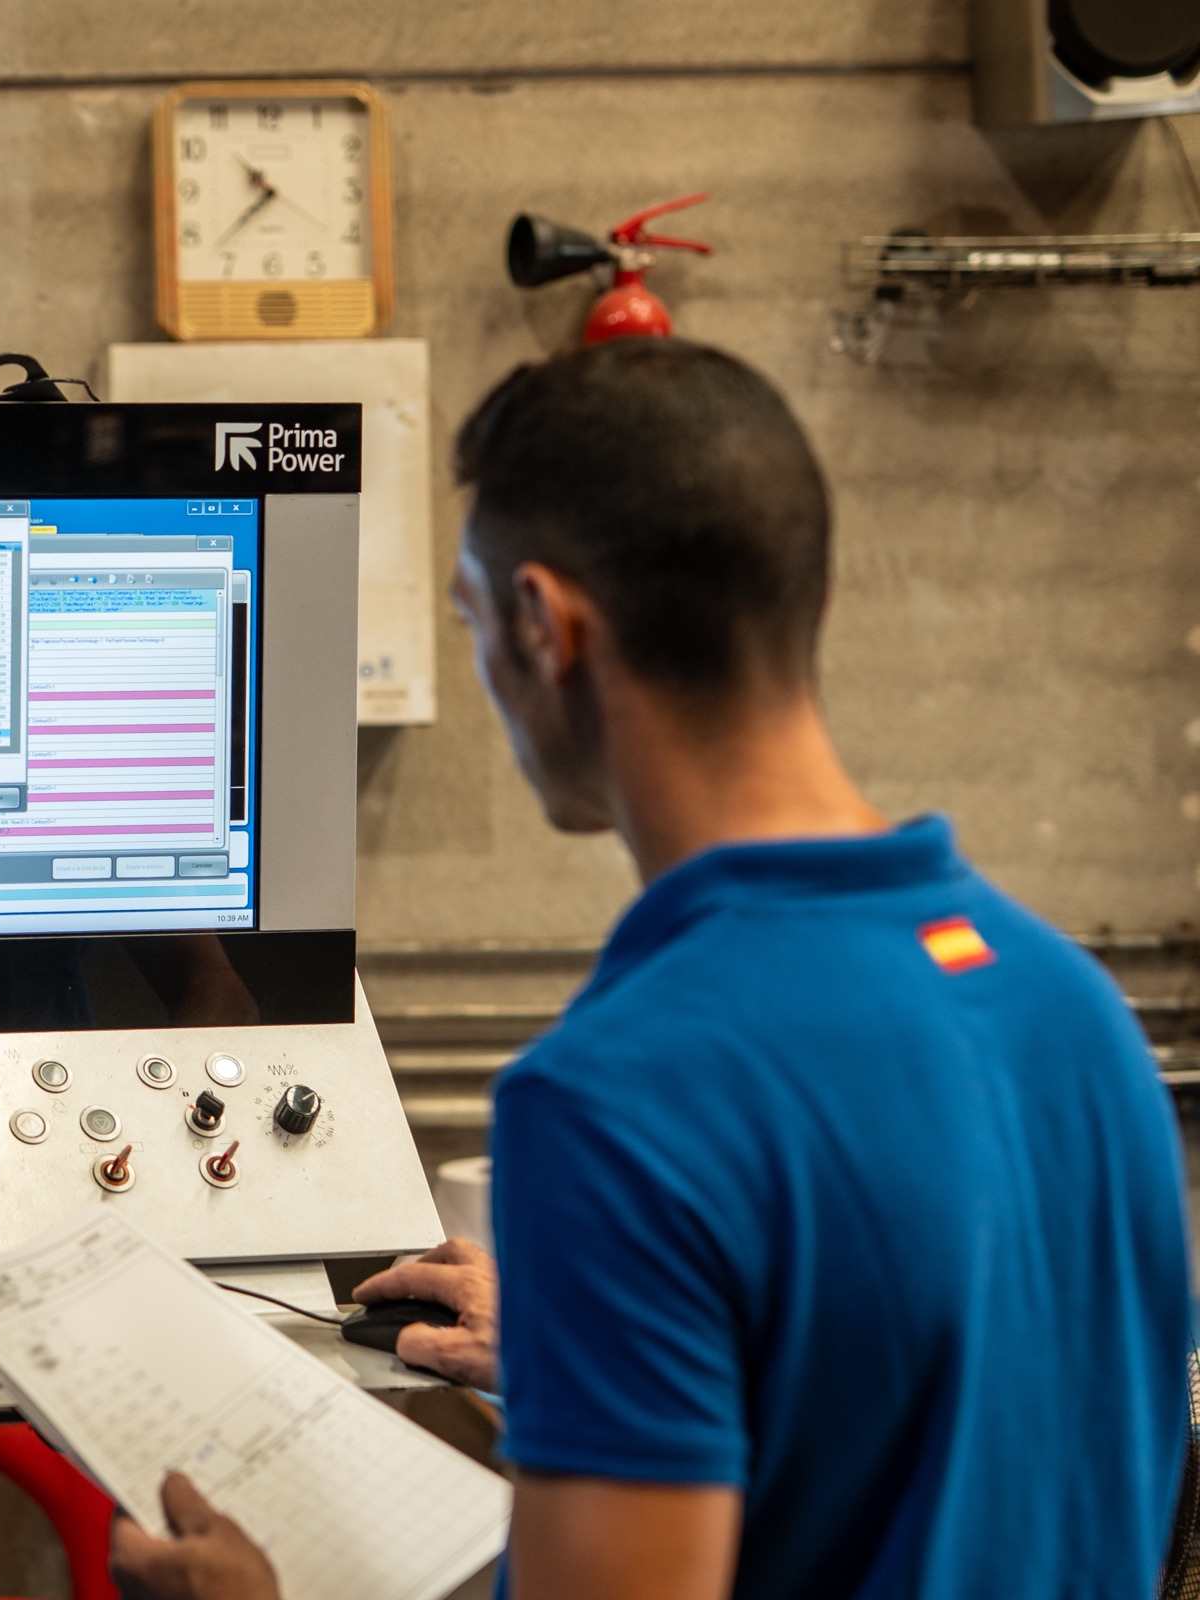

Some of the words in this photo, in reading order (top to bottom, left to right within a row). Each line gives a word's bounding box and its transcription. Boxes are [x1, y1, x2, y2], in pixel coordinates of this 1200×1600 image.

[210, 104, 228, 130] 11
[258, 104, 282, 130] 12
[313, 104, 322, 129] 1
[180, 136, 207, 162] 10
[342, 134, 362, 162] 2
[179, 178, 199, 203] 9
[342, 177, 362, 204] 3
[180, 221, 201, 247] 8
[340, 221, 361, 246] 4
[220, 252, 237, 279] 7
[262, 252, 283, 279] 6
[304, 252, 326, 279] 5
[269, 423, 337, 448] Prima
[269, 448, 345, 472] Power
[315, 1139, 326, 1148] 120
